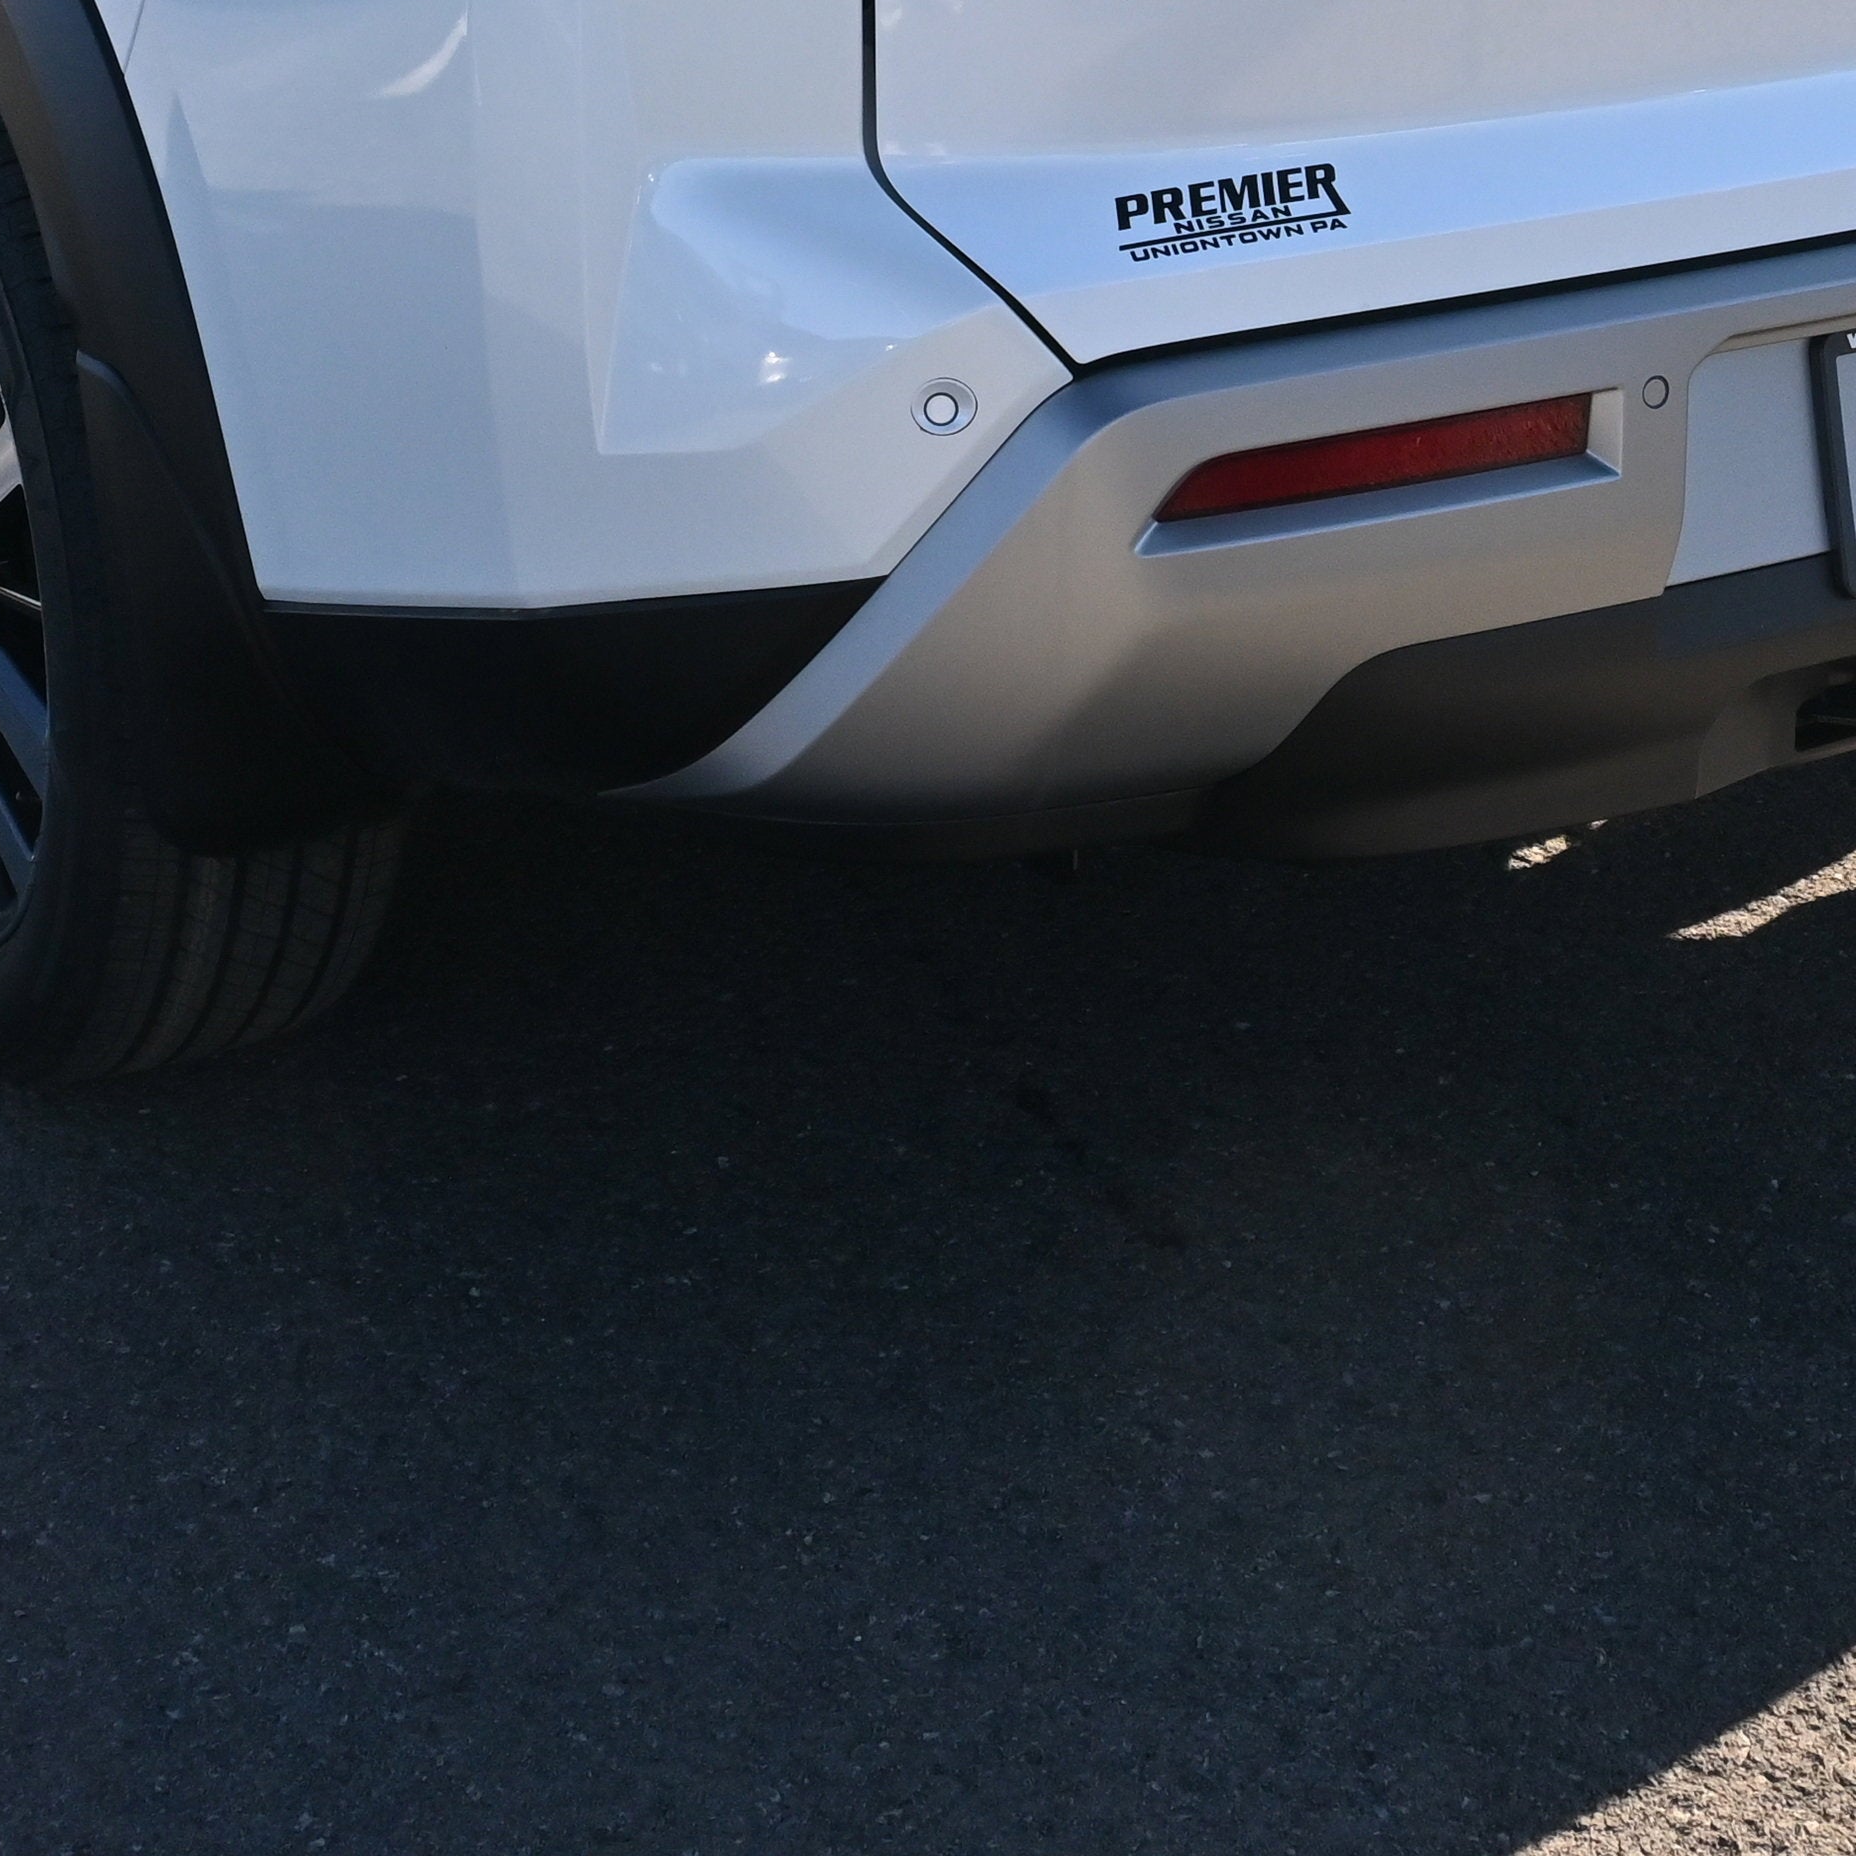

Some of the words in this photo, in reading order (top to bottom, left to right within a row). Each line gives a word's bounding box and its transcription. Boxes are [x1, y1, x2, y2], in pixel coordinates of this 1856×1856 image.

[1115, 163, 1352, 232] PREMIER
[1174, 205, 1292, 235] NISSAN
[1130, 225, 1305, 263] UNIONTOWN
[1311, 218, 1349, 234] PA
